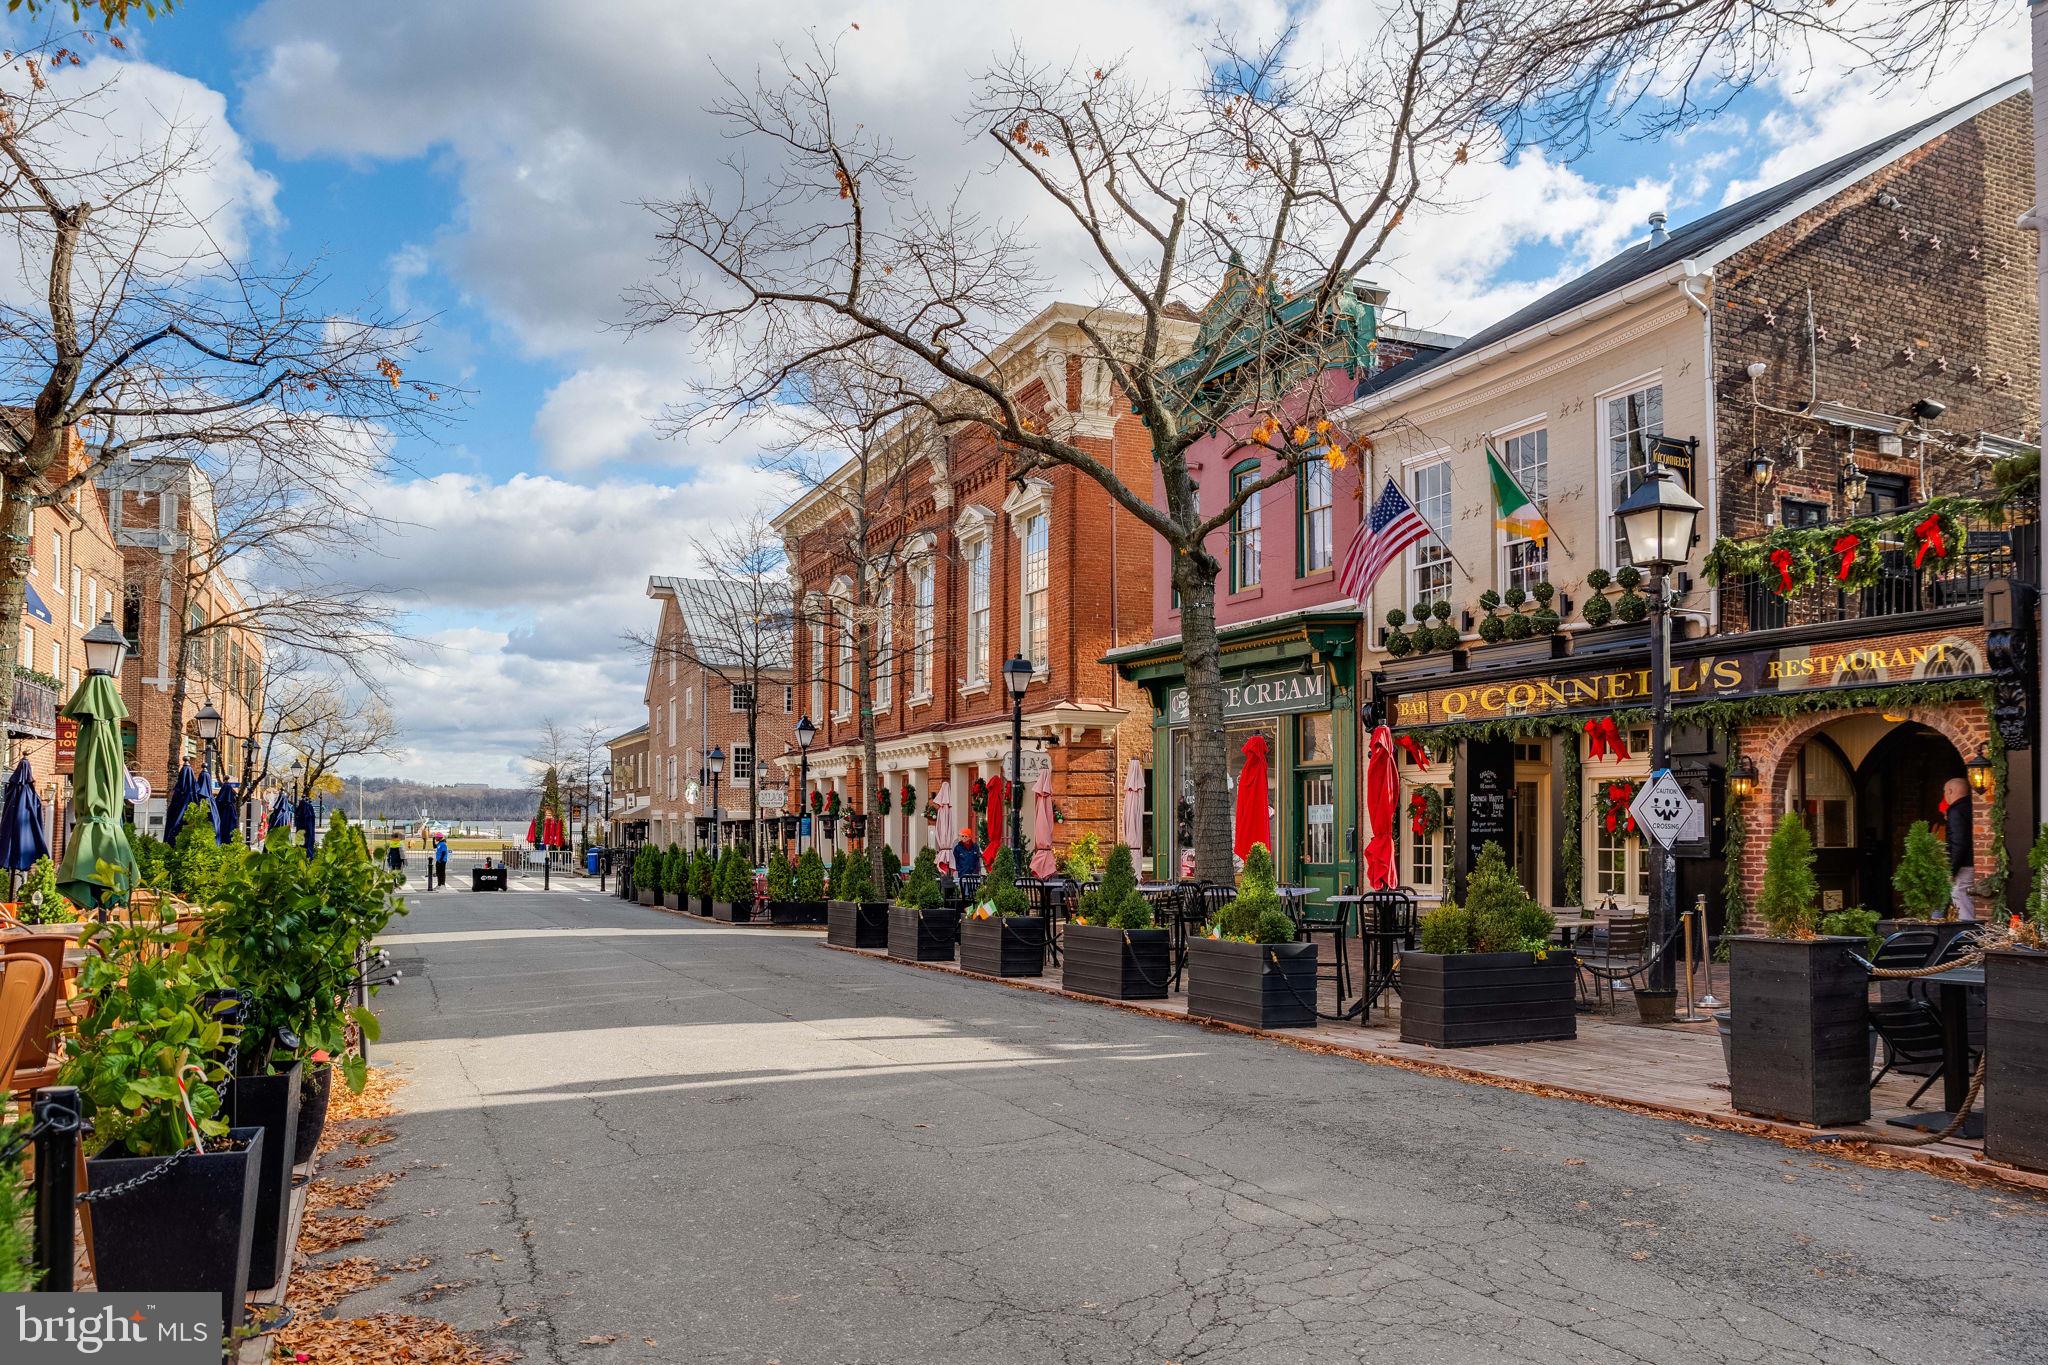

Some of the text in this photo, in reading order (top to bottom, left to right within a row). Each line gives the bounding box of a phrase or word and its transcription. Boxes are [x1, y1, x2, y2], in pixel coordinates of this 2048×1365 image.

[1243, 674, 1323, 706] CREAM
[1399, 700, 1428, 717] BAR
[1767, 643, 1953, 680] RESTAURANT
[1653, 822, 1679, 830] CROSSING
